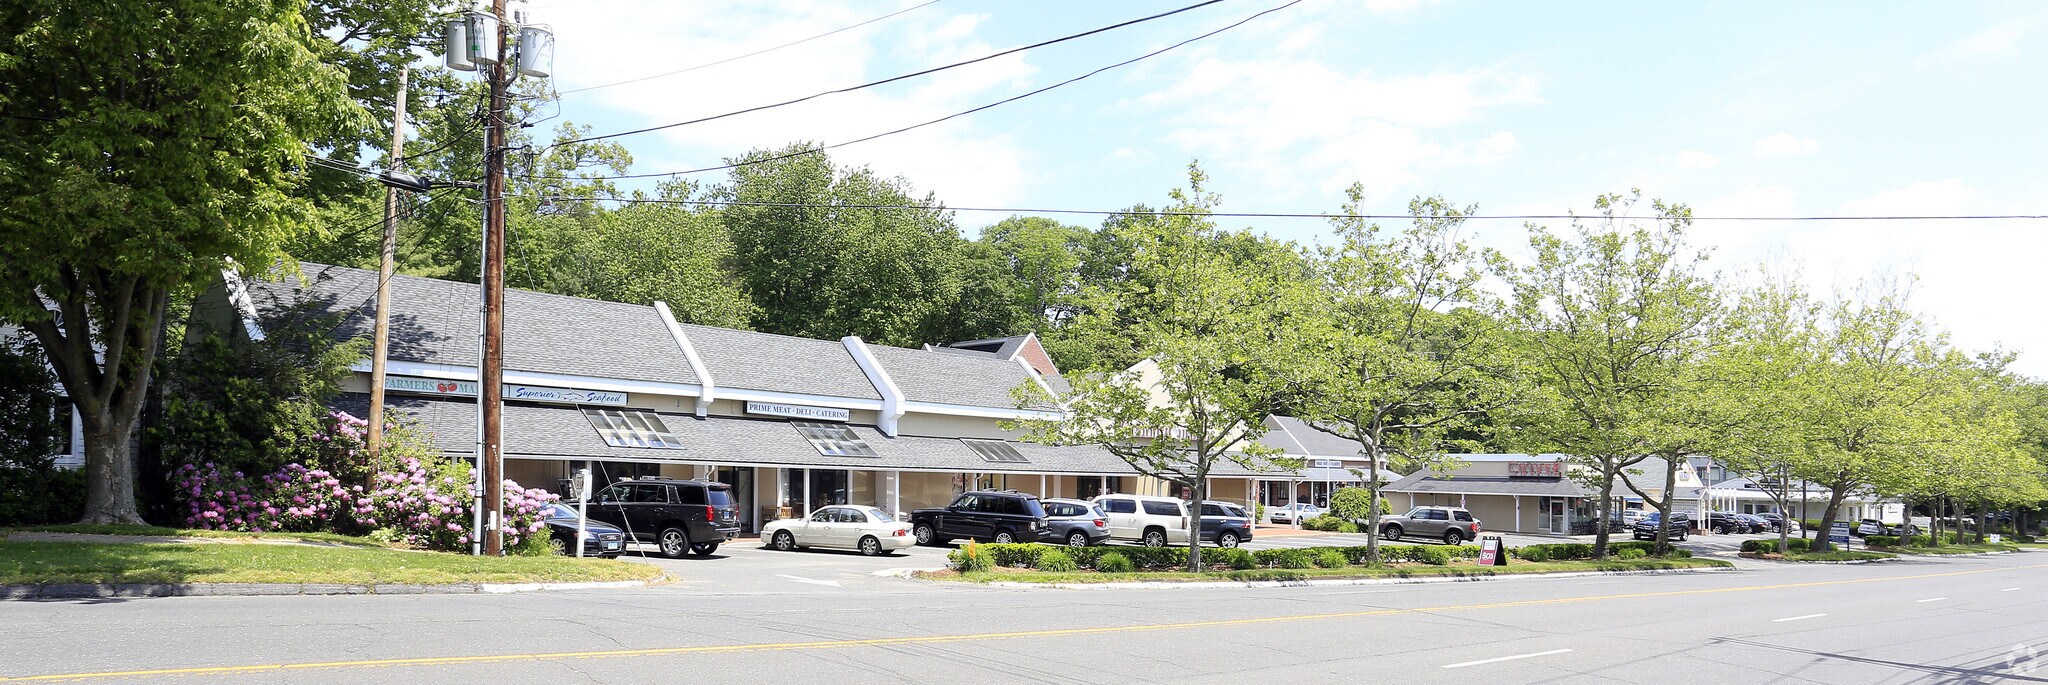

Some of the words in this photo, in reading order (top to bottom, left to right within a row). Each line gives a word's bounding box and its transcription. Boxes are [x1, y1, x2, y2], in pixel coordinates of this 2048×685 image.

[385, 378, 434, 390] FARMERS
[516, 387, 554, 398] Superior
[587, 392, 621, 402] Seafood
[749, 403, 772, 412] PRIME
[773, 406, 791, 414] MEAT
[796, 407, 812, 416] DELI
[816, 409, 848, 419] CATERING
